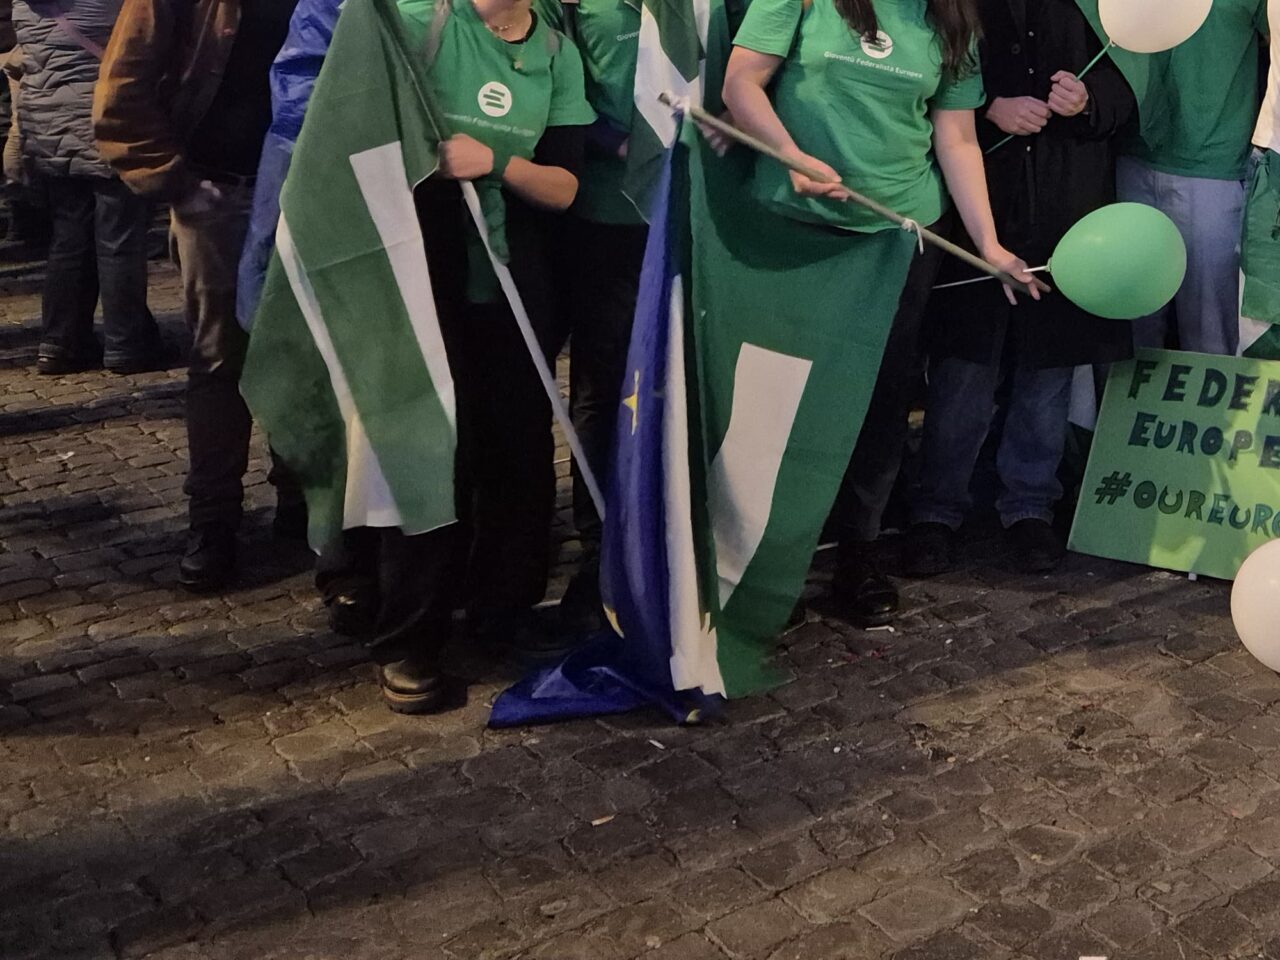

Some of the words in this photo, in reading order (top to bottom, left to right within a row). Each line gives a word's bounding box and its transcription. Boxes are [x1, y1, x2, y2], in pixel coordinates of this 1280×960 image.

[824, 51, 855, 63] Gioventù
[856, 58, 894, 73] Federalista
[895, 67, 923, 79] Europea
